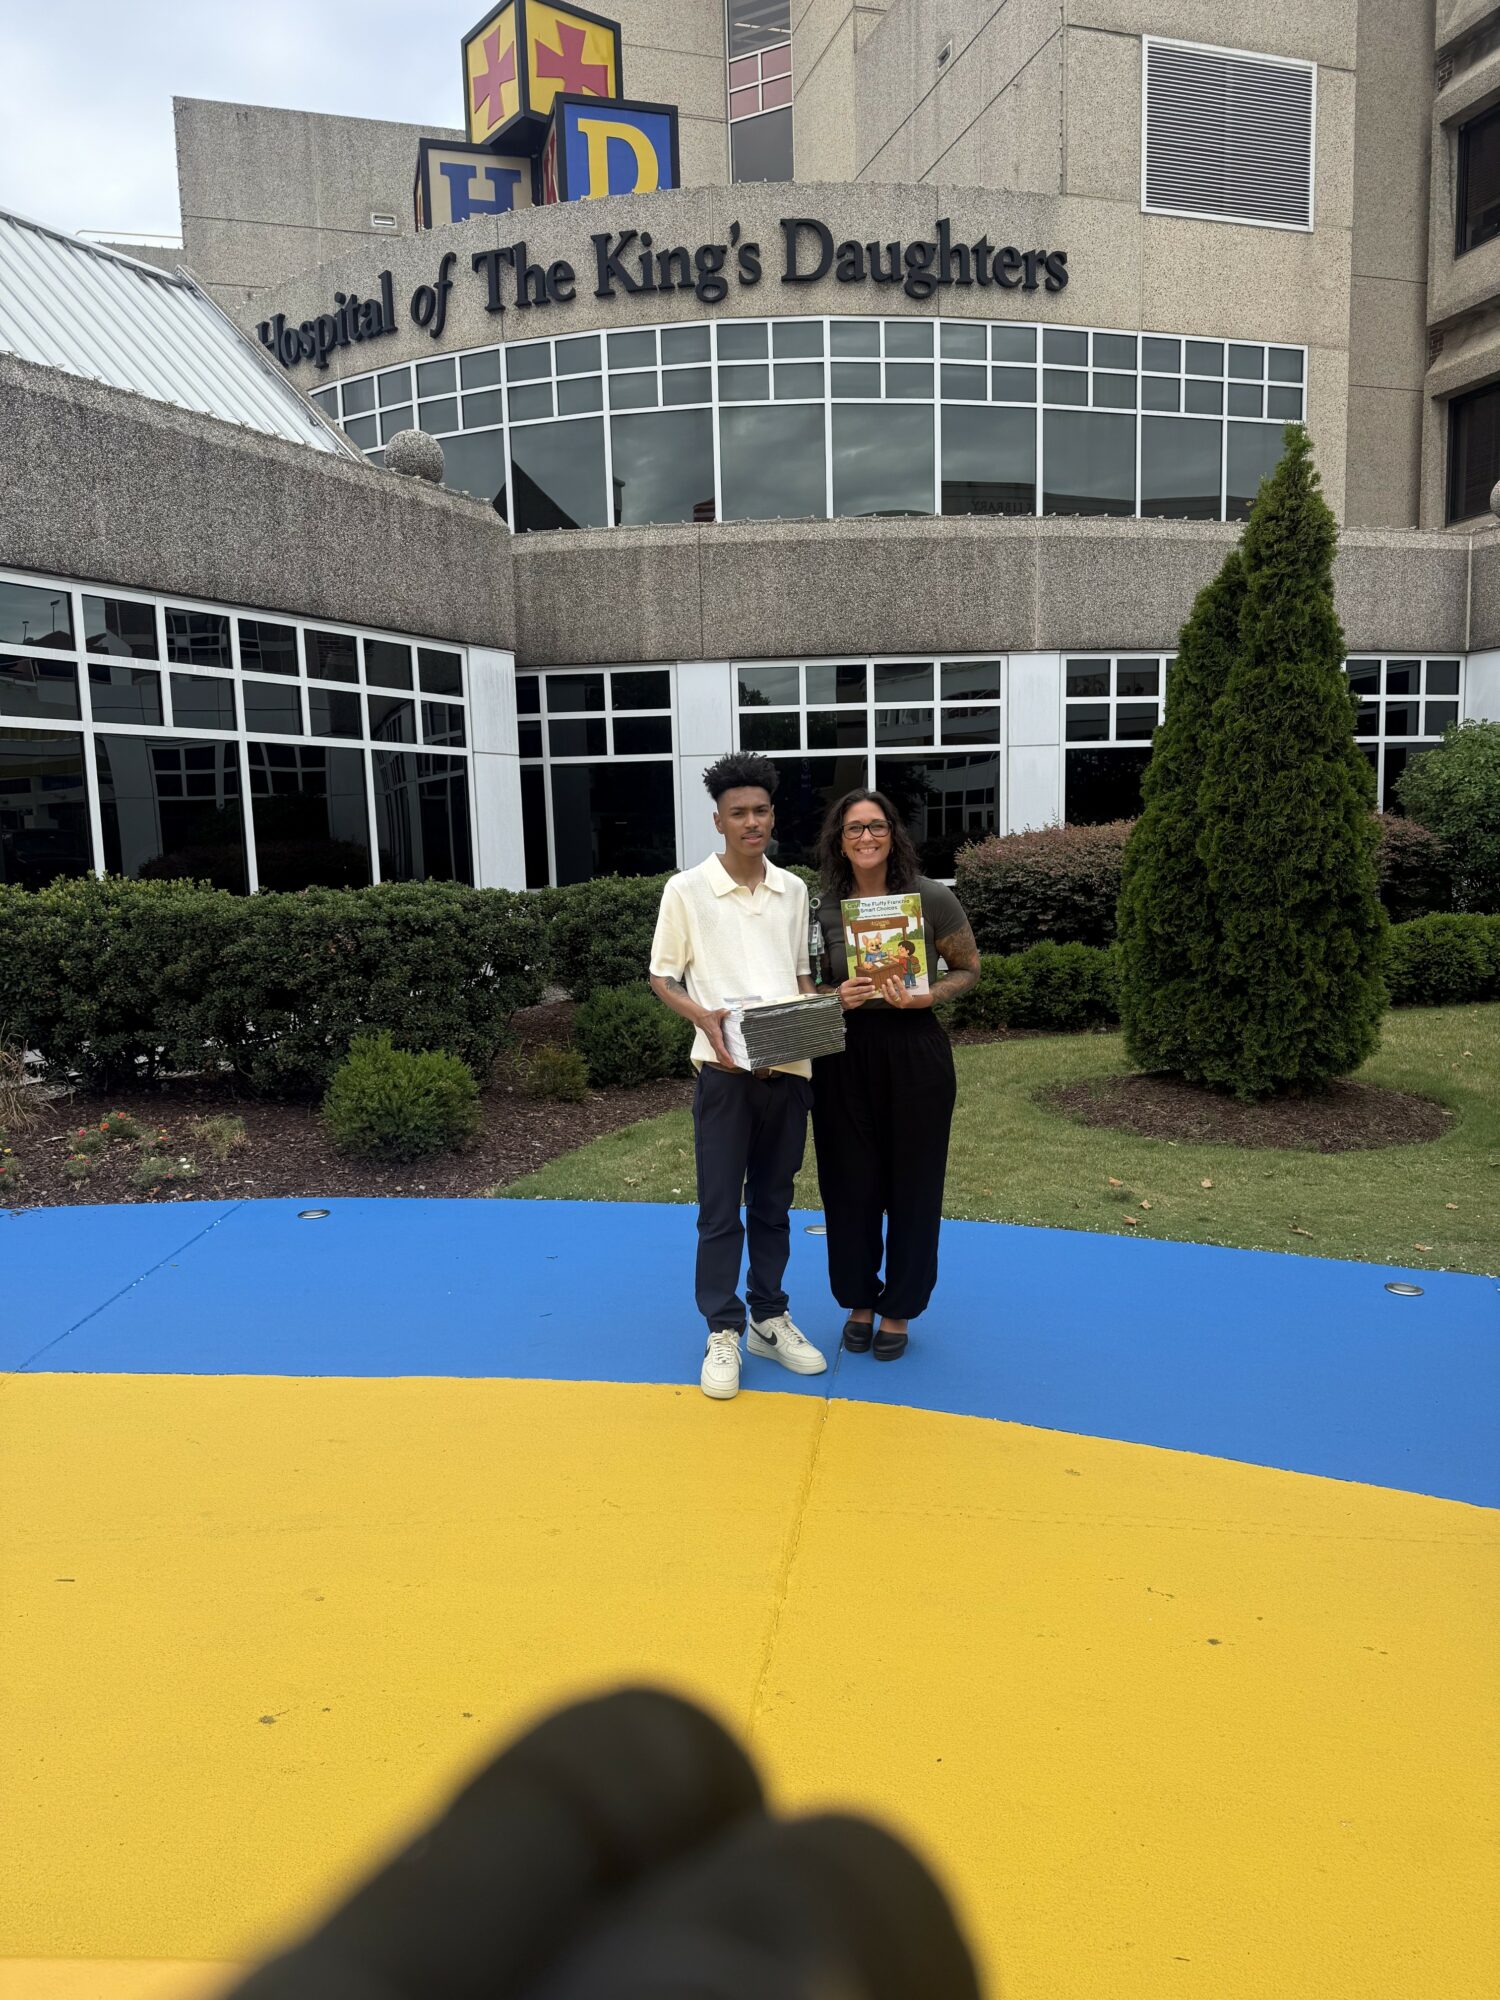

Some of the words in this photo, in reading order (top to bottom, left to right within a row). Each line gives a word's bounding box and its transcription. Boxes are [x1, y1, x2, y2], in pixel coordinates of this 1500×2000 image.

[440, 162, 521, 223] H
[577, 118, 659, 200] D
[255, 269, 398, 369] Hospital
[410, 252, 456, 338] of
[472, 241, 576, 312] The
[591, 220, 762, 303] King's
[780, 218, 1068, 299] Daughters
